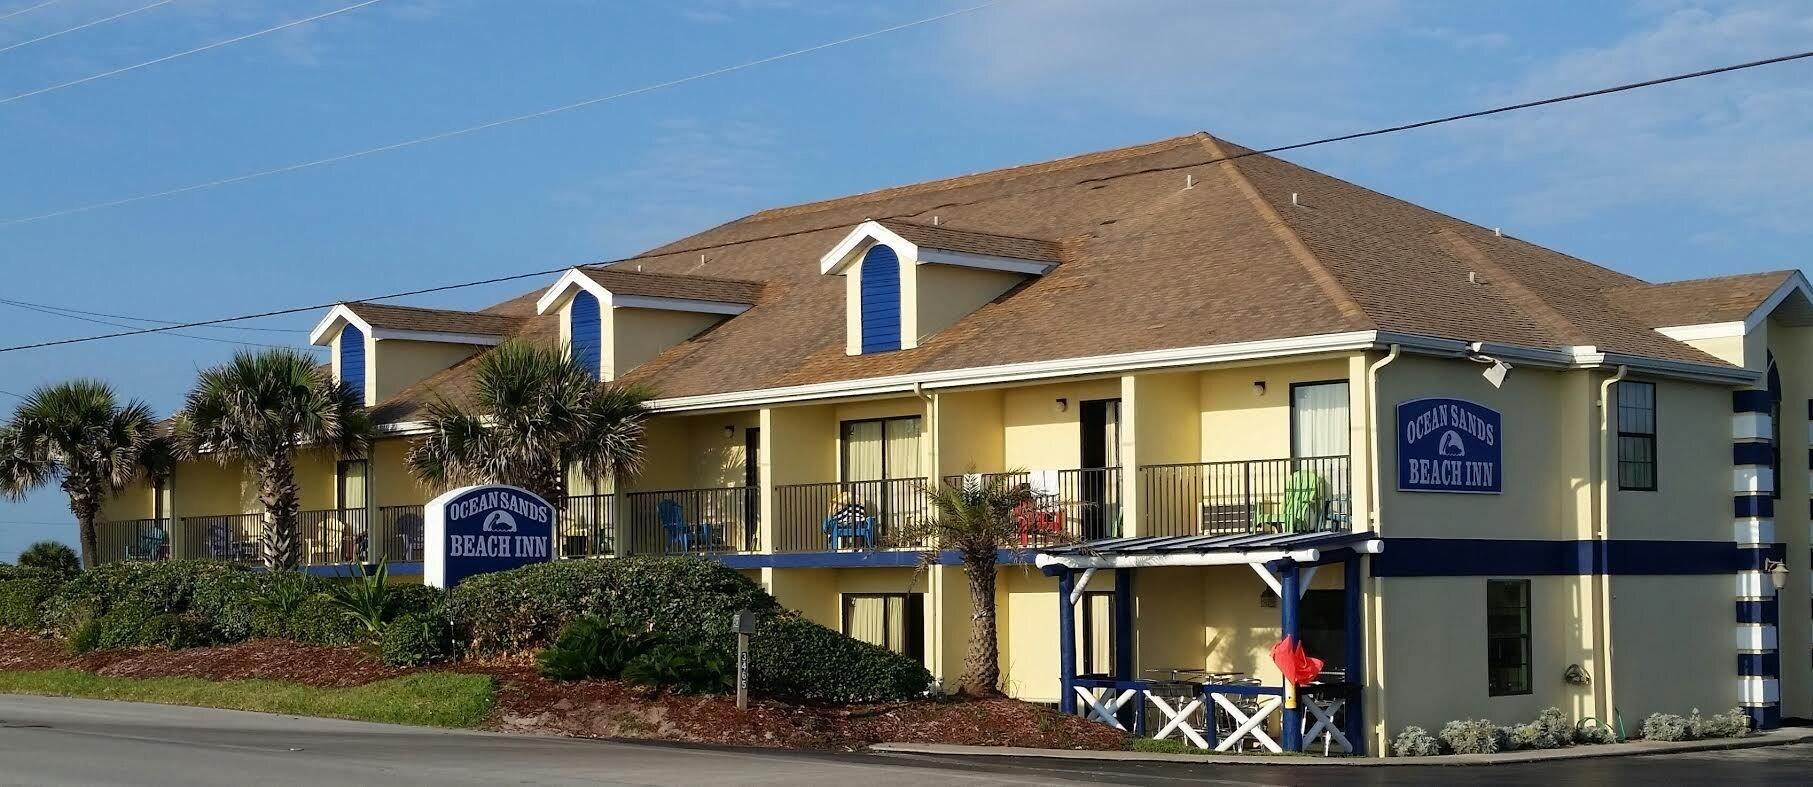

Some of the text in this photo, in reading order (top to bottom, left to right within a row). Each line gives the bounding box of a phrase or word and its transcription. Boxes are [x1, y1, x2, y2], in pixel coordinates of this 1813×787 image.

[1407, 405, 1494, 446] OCEAN SANDS
[1409, 459, 1493, 487] BEACH INN
[450, 491, 548, 523] OCEAN SANDS
[450, 535, 548, 558] BEACH INN
